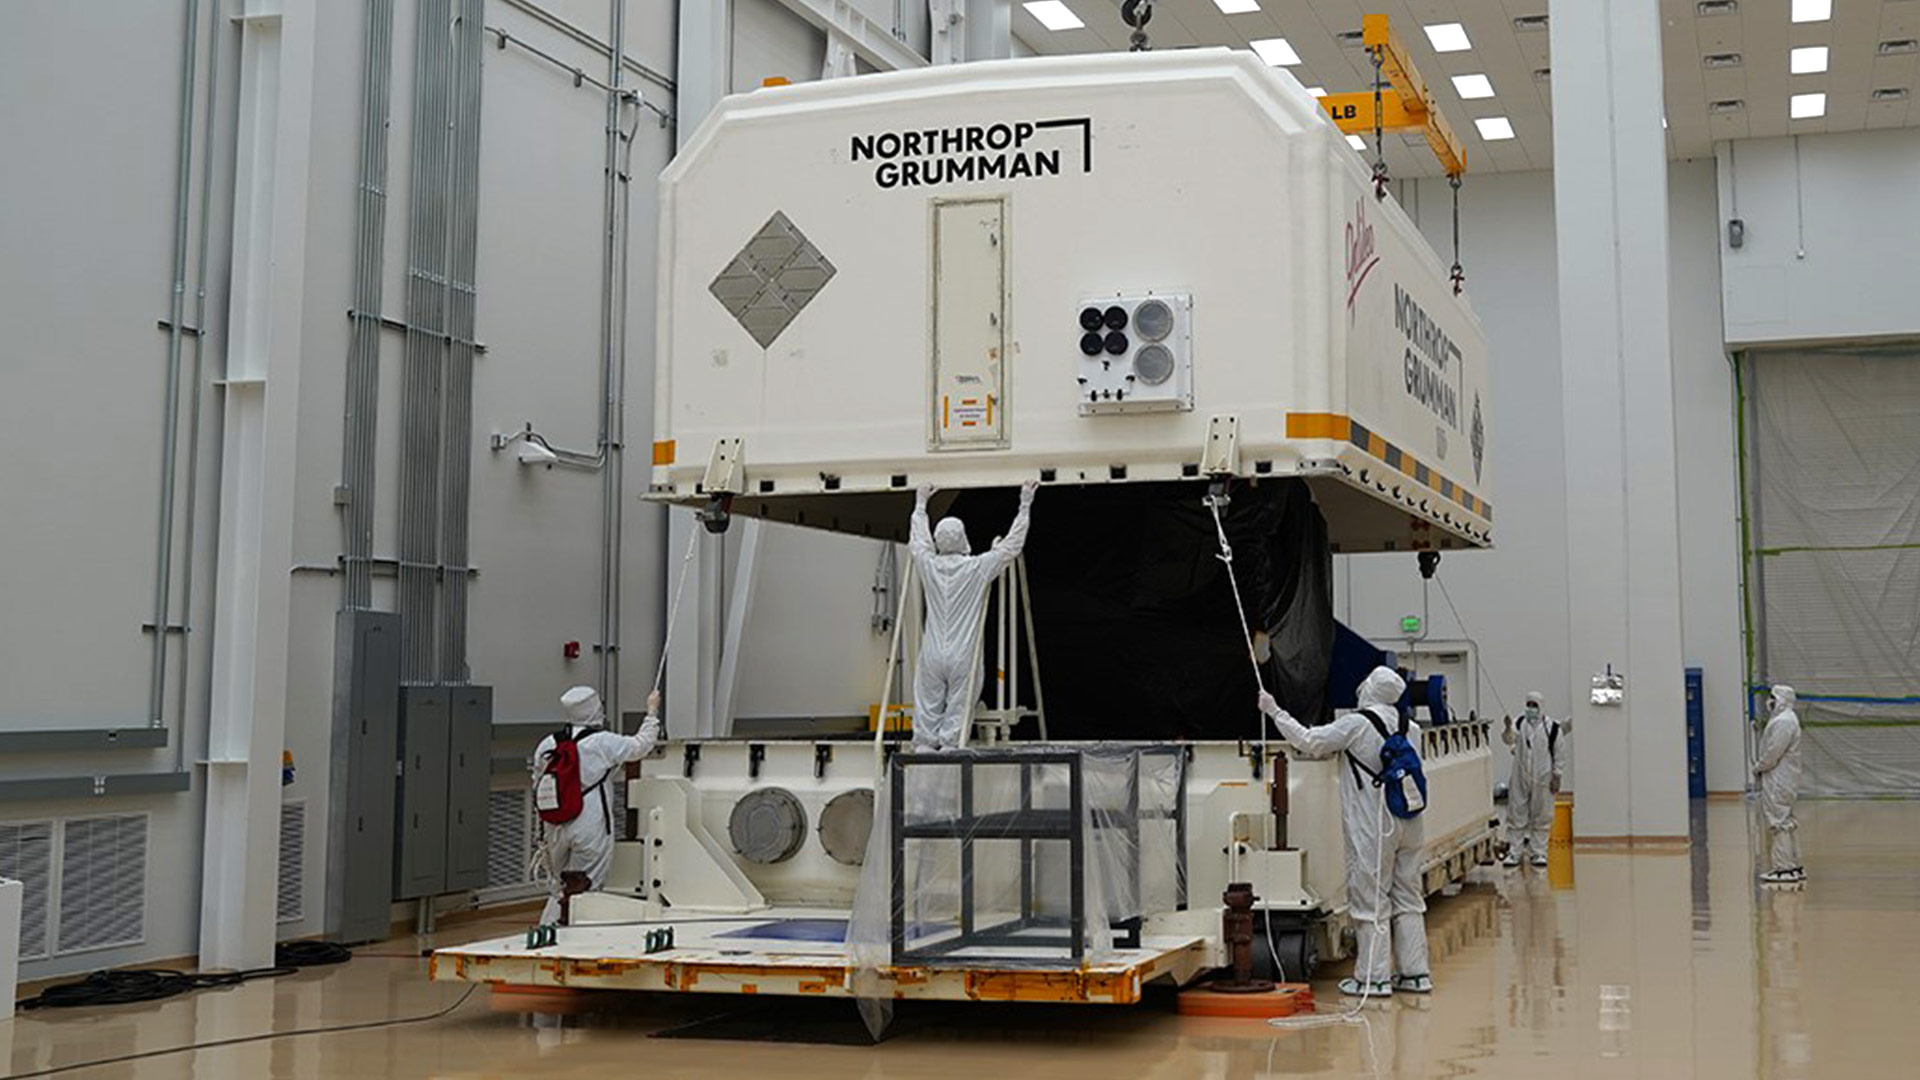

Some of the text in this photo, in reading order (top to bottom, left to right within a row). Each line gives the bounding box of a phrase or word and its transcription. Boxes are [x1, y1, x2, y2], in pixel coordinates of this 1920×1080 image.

[1332, 104, 1357, 119] LB
[850, 122, 1034, 161] NORTHROP
[875, 150, 1060, 188] GRUMMAN
[1394, 282, 1450, 373] NORTHROP
[1404, 346, 1457, 430] GRUMMAN
